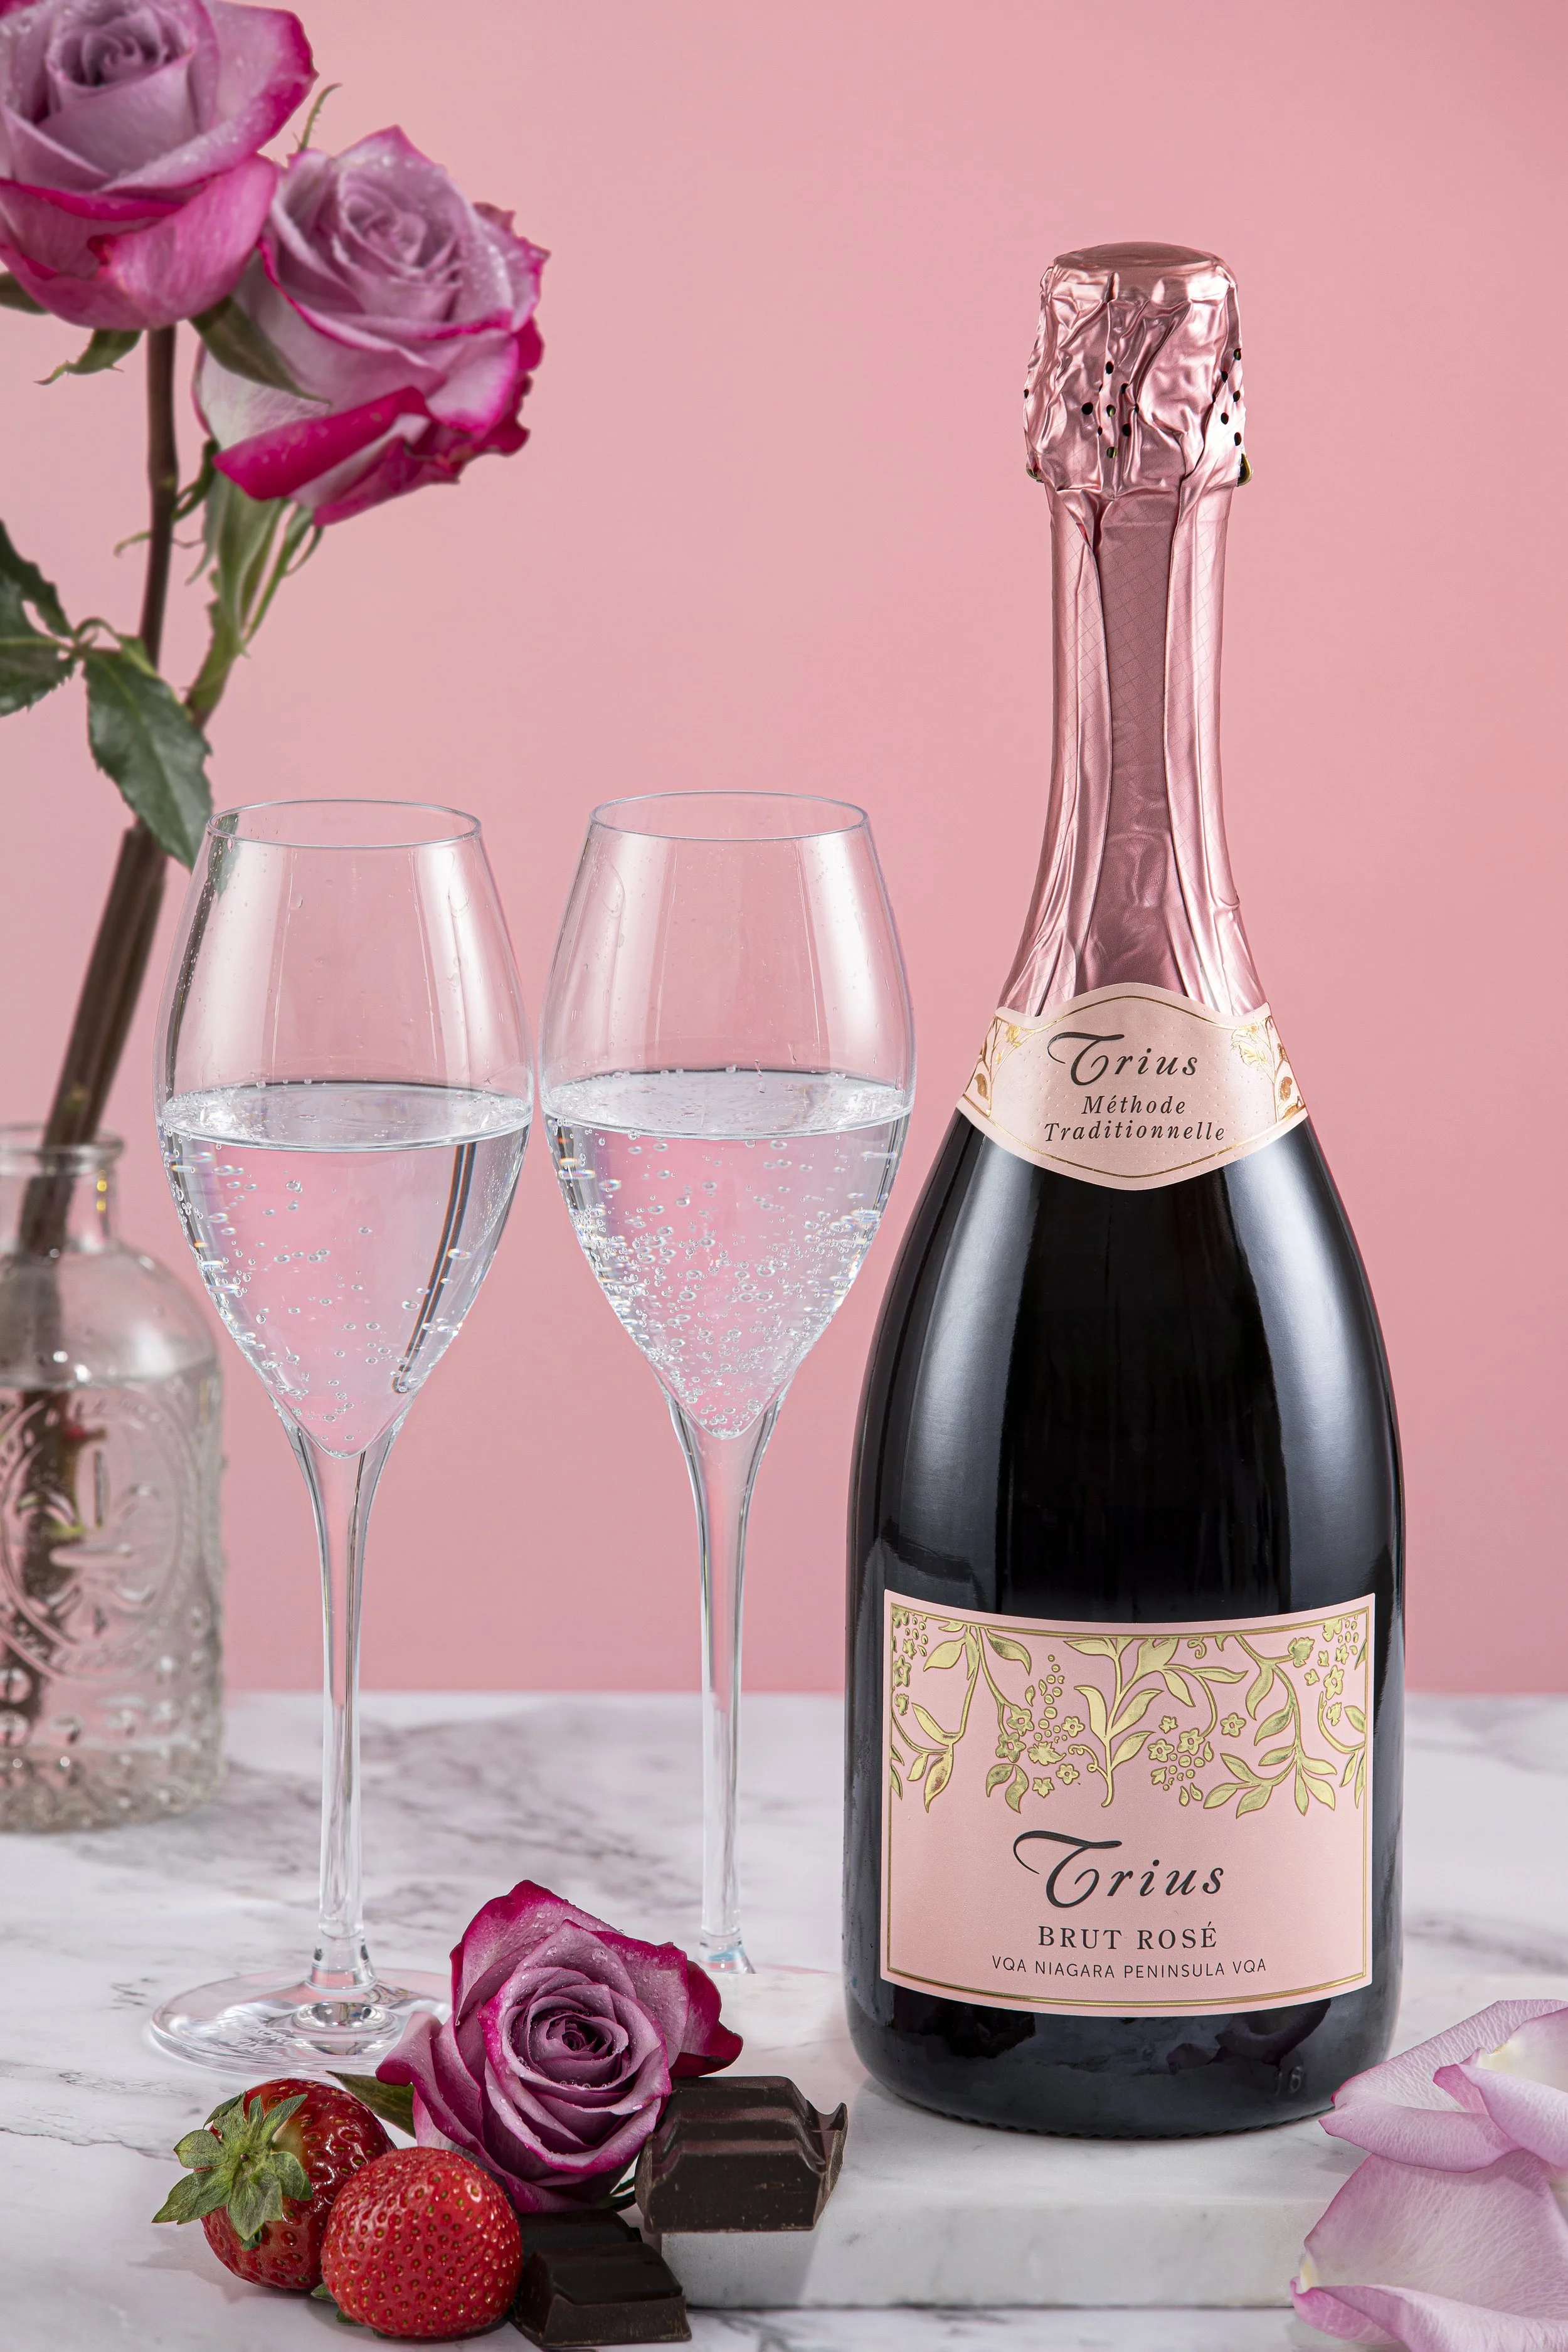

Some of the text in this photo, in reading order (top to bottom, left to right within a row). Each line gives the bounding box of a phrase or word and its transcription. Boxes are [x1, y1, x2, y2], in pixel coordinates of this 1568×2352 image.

[1047, 1031, 1199, 1086] Trius
[1080, 1094, 1186, 1115] Méthode
[1043, 1119, 1225, 1143] Traditionnelle
[1013, 1830, 1225, 1909] Trius
[1037, 1920, 1217, 1951] BRUT ROSÉ
[991, 1954, 1267, 1979] VQA NIAGARA PENINSULA VQA
